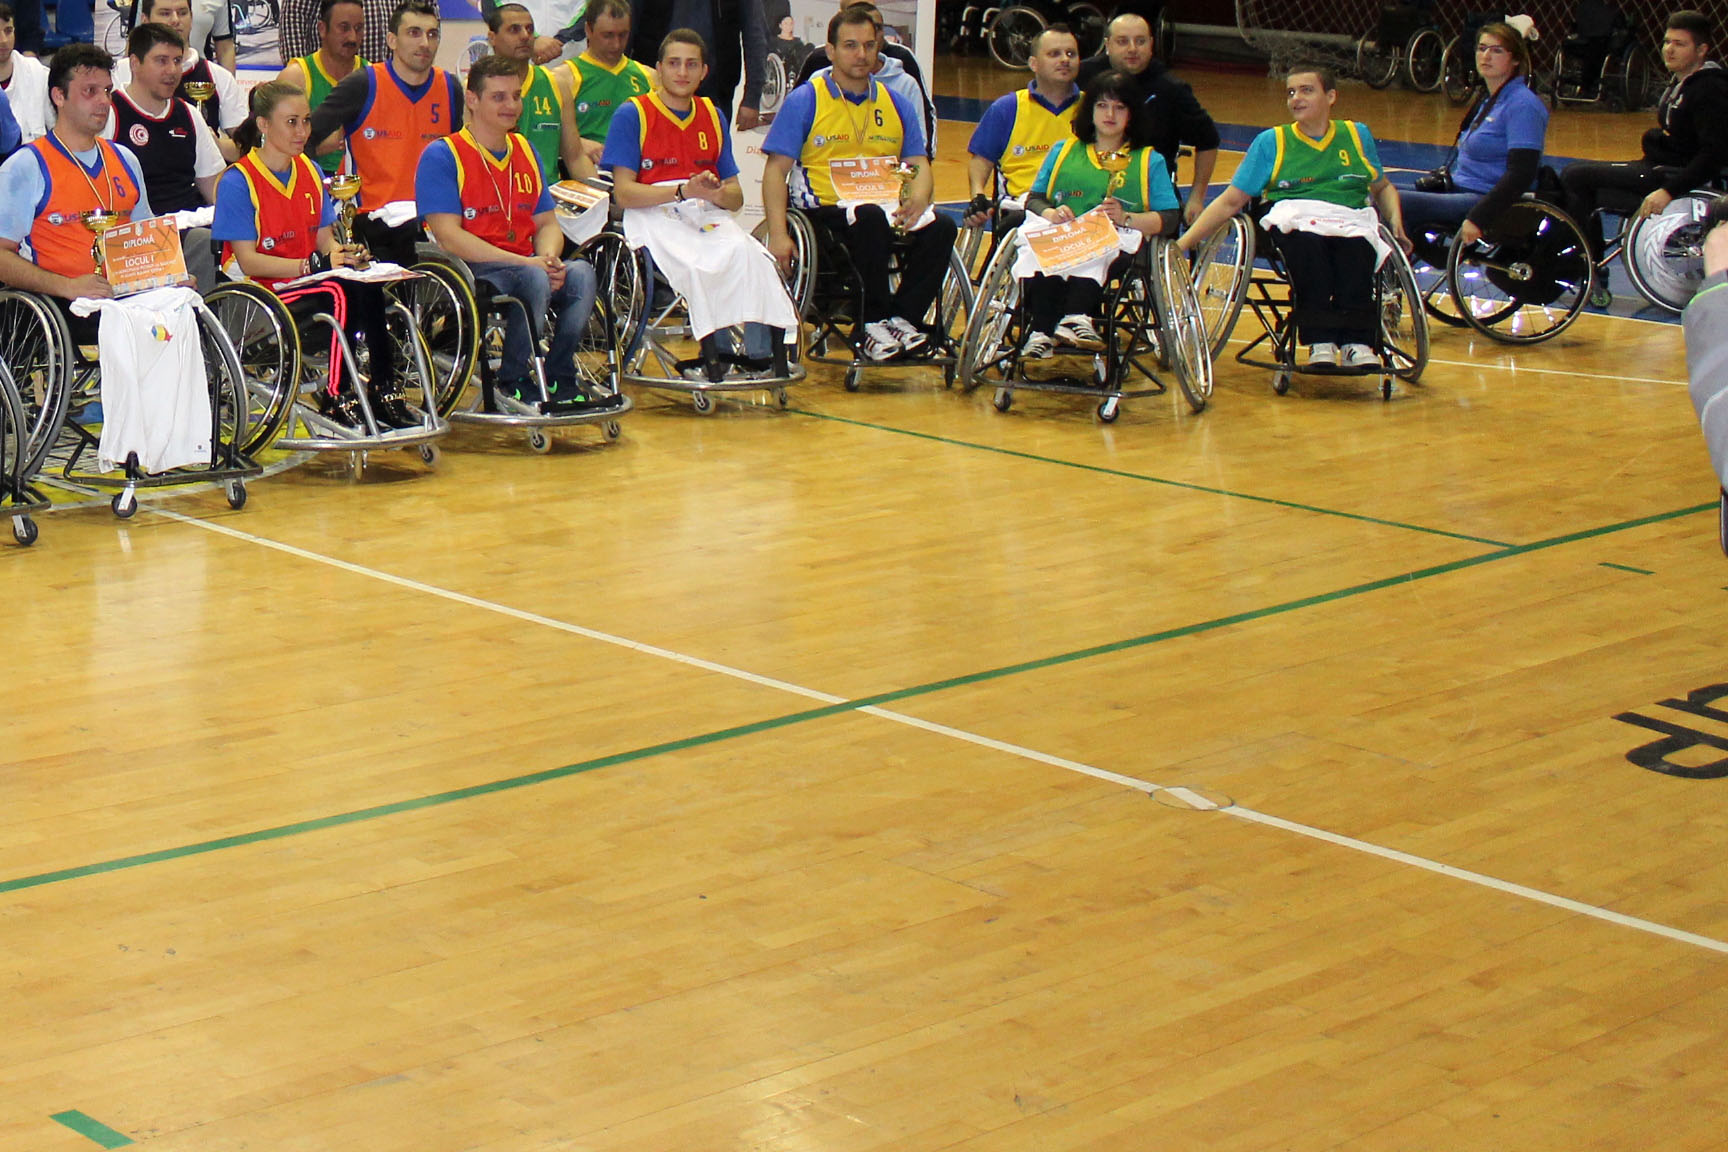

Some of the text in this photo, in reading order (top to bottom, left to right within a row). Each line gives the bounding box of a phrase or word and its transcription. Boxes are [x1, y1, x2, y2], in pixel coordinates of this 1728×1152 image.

[630, 76, 640, 93] 5
[430, 103, 440, 123] 5
[533, 95, 553, 115] 14
[874, 109, 884, 127] 6
[697, 131, 708, 151] 8
[825, 134, 850, 142] USAID
[1025, 144, 1050, 152] USAID
[1338, 149, 1350, 166] 9
[113, 176, 126, 198] 6
[514, 171, 533, 194] 10
[304, 192, 316, 215] 7
[125, 255, 150, 268] LOCUL
